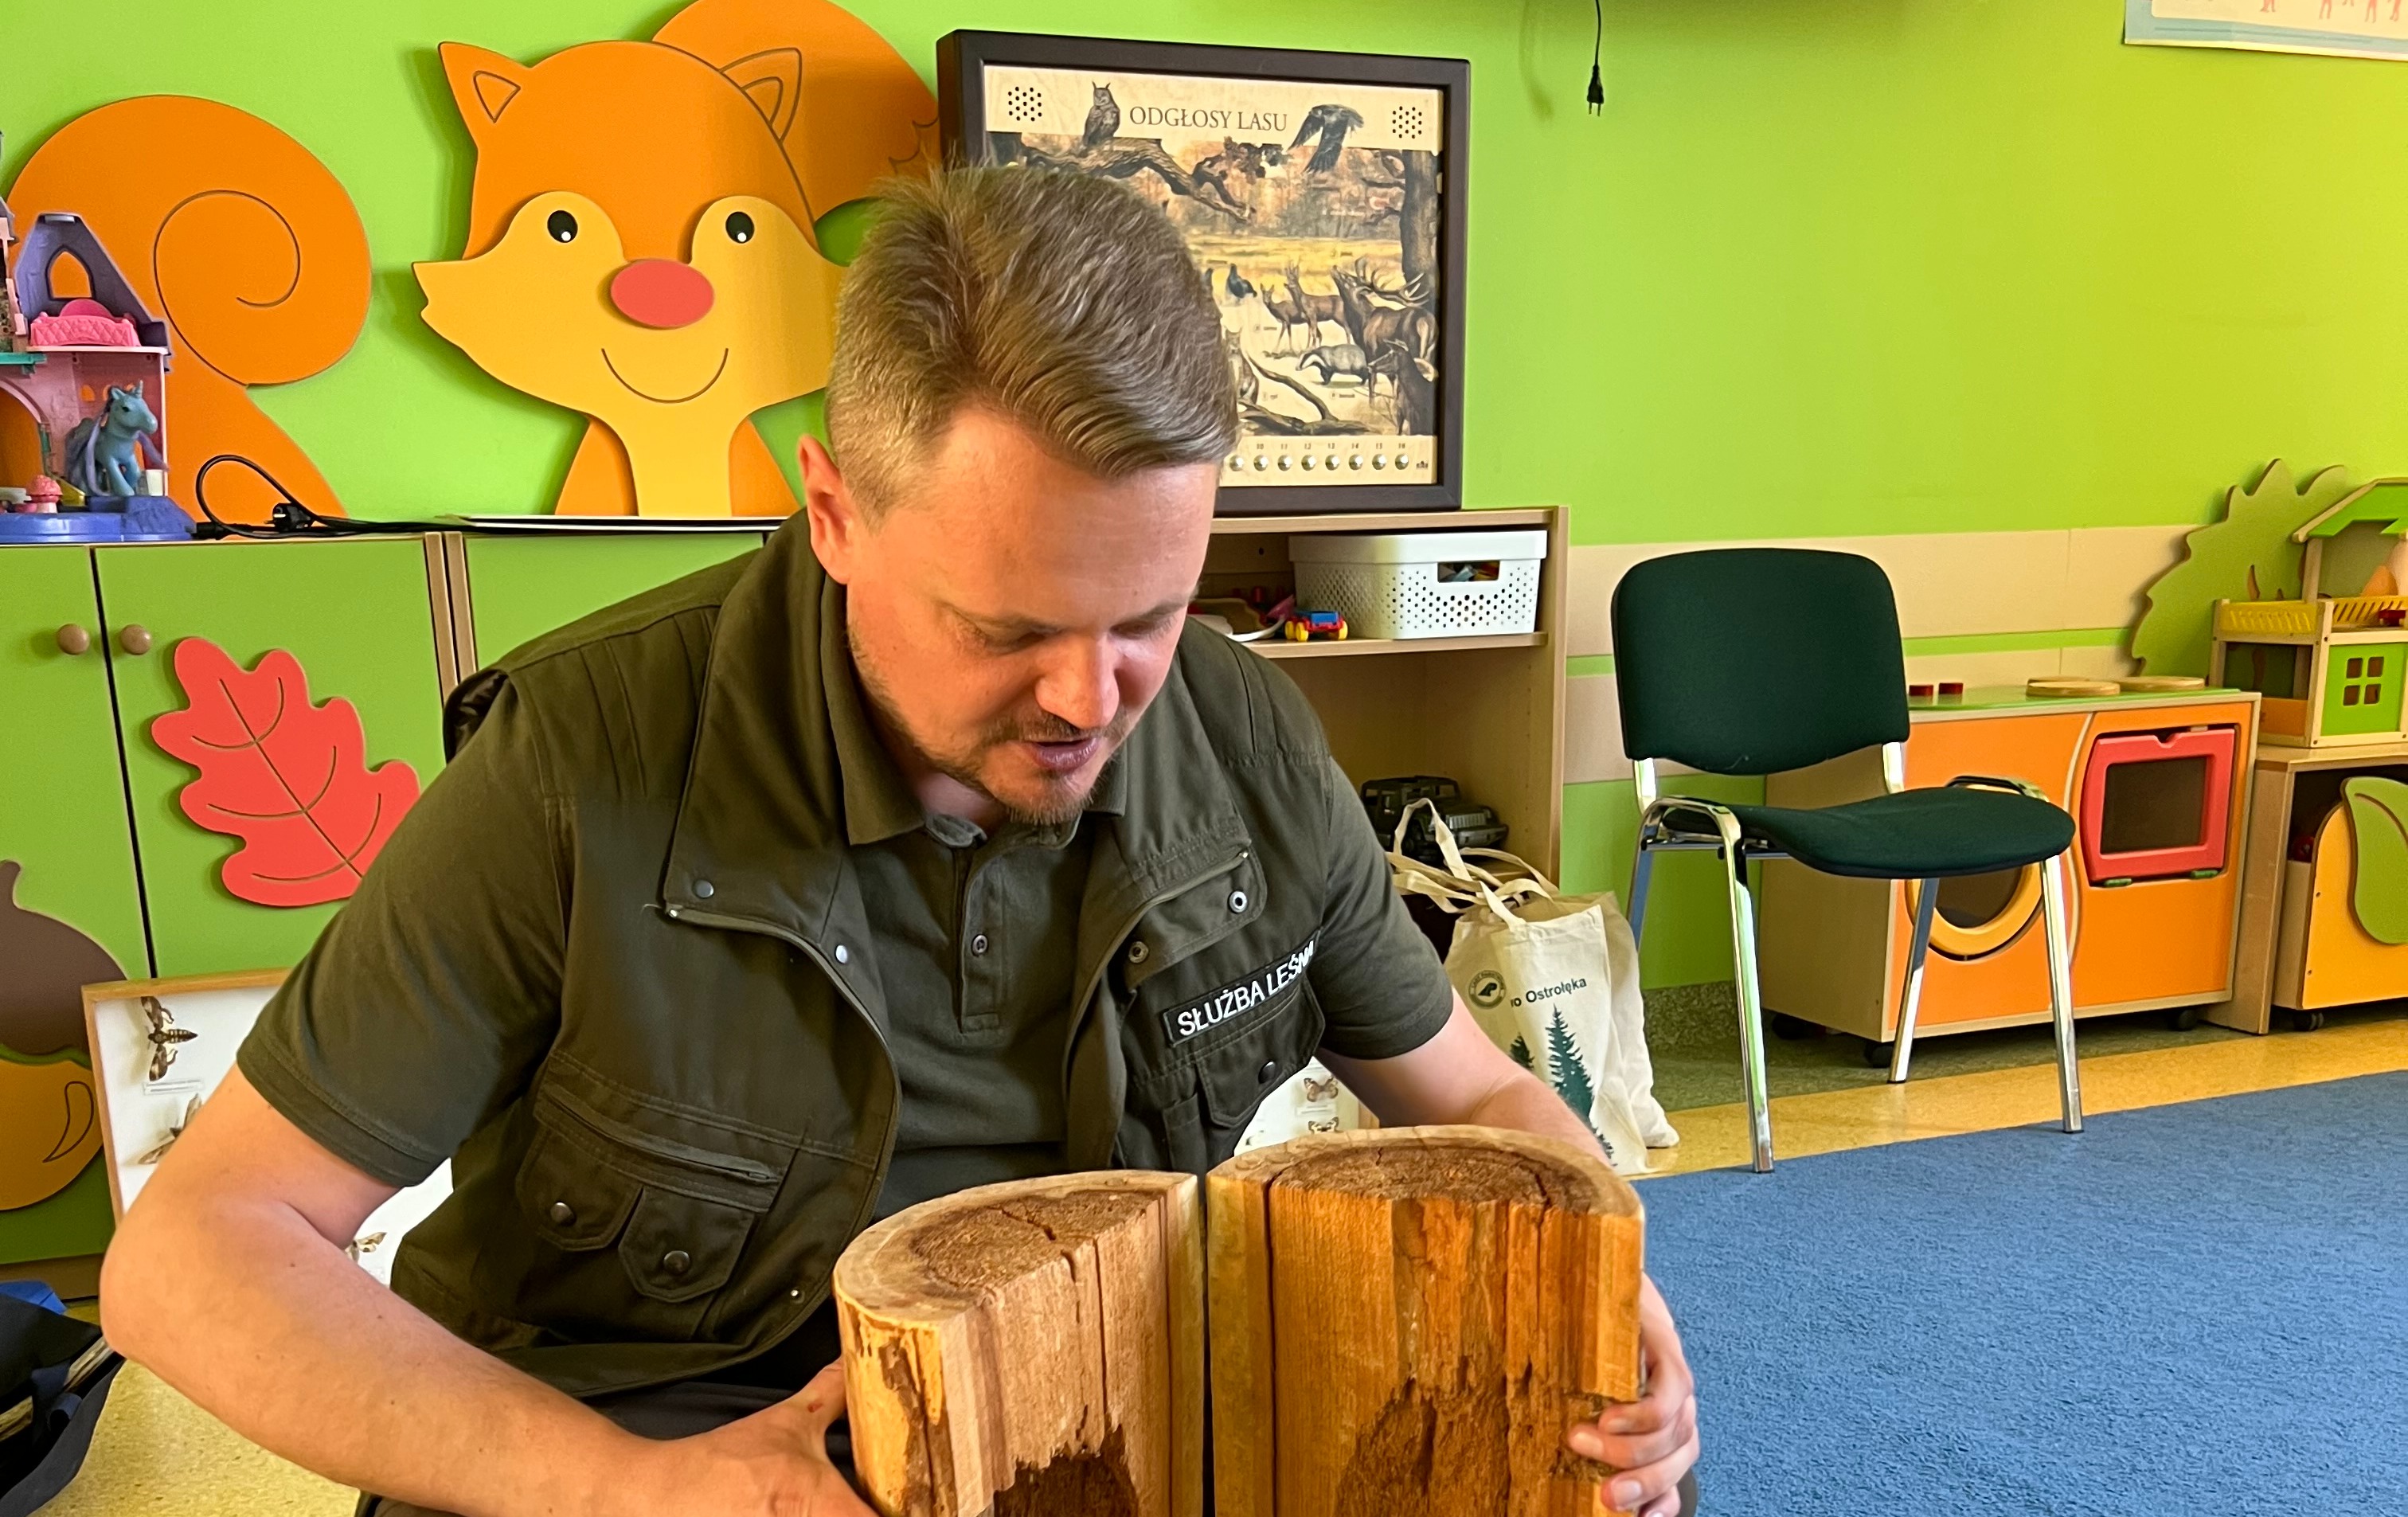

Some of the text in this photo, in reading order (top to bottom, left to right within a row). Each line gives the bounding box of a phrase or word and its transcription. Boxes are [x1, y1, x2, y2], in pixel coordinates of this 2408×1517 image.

[1129, 106, 1288, 131] ODGŁOSY LASU
[1525, 977, 1587, 1003] Ostrołęka
[1177, 980, 1265, 1036] SŁUŻBA
